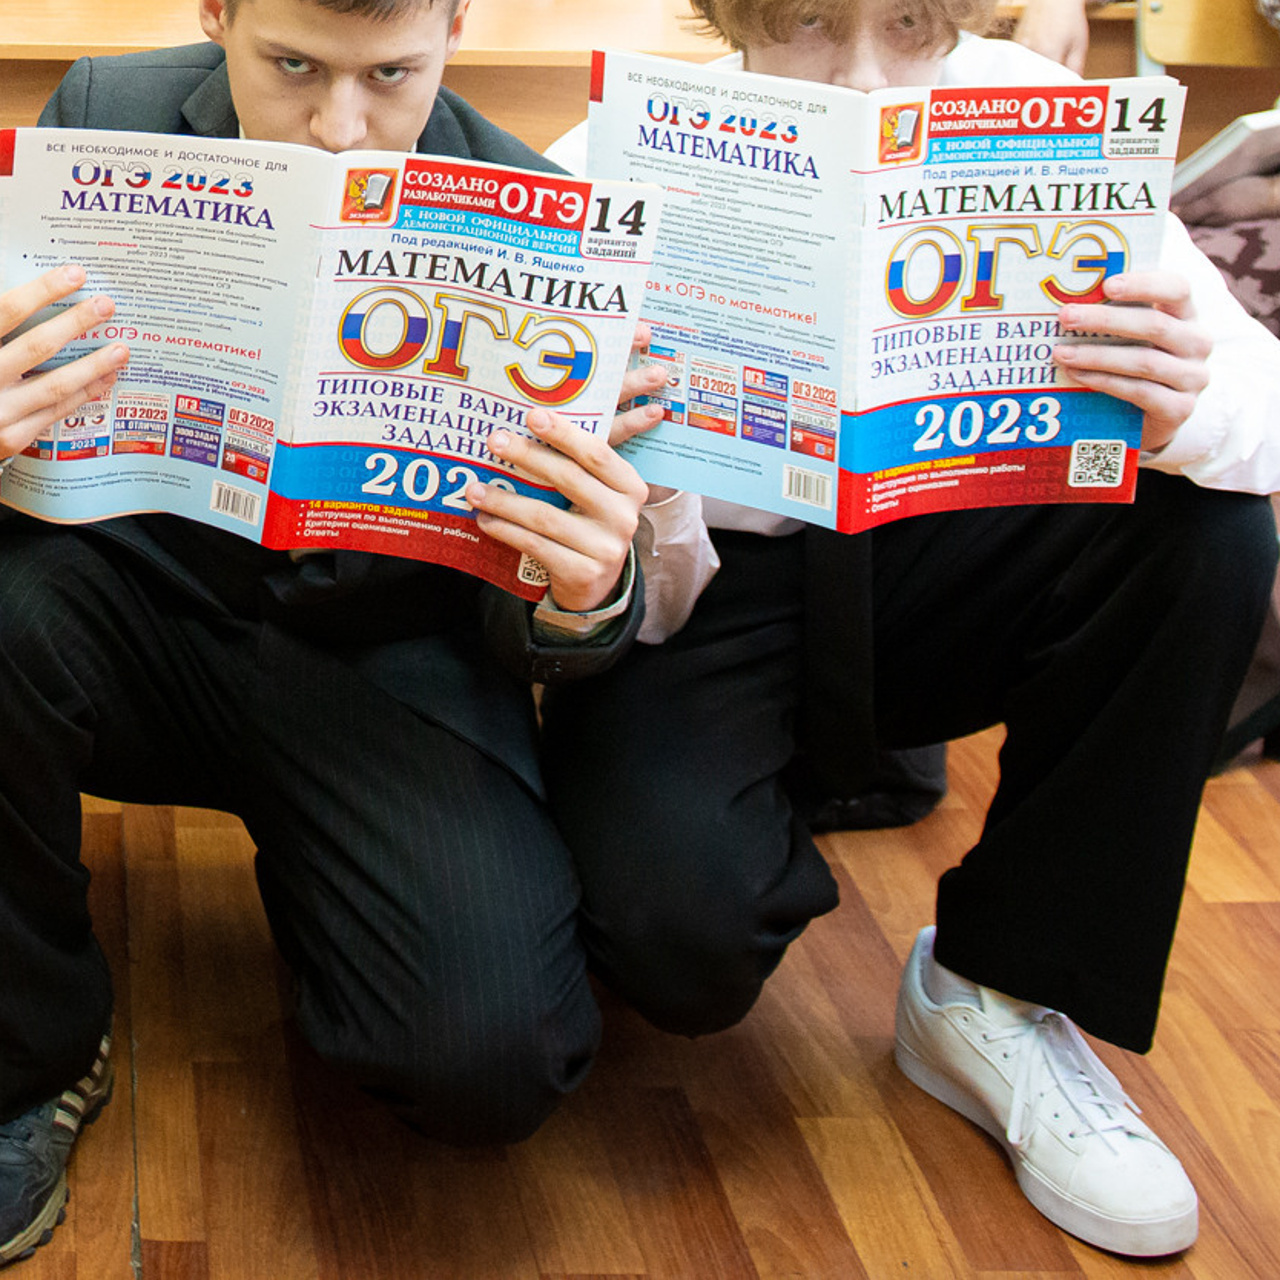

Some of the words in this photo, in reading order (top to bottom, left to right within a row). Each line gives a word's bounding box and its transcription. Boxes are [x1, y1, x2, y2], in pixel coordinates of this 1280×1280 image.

[628, 72, 643, 83] ВСЕ
[646, 77, 717, 96] НЕОБХОДИМОЕ
[732, 91, 803, 111] ДОСТАТОЧНОЕ
[807, 103, 828, 114] ДЛЯ
[930, 99, 1020, 118] СОЗДАНО
[930, 118, 1019, 132] РАЗРАБОТЧИКАМИ
[1021, 96, 1104, 129] ОГЭ
[1111, 97, 1168, 134] 14
[46, 143, 65, 153] ВСЕ
[71, 145, 159, 158] НЕОБХОДИМОЕ
[165, 150, 173, 158] И
[178, 150, 260, 169] ДОСТАТОЧНОЕ
[265, 161, 288, 172] ДЛЯ
[637, 124, 820, 180] МАТЕМАТИКА
[932, 140, 941, 152] К
[946, 138, 992, 151] НОВОЙ
[996, 136, 1100, 150] ОФИЦИАЛЬНОЙ
[71, 158, 152, 189] ОГЭ
[161, 164, 254, 198] 2023
[404, 170, 499, 195] СОЗДАНО
[922, 168, 947, 180] Под
[950, 165, 1020, 180] редакцией
[1024, 165, 1038, 176] И.
[1041, 166, 1054, 176] В.
[1058, 165, 1109, 178] Ященко
[60, 189, 276, 230] МАТЕМАТИКА
[403, 189, 496, 209] РАЗРАБОТЧИКАМИ
[499, 182, 585, 224] ОГЭ
[878, 182, 1156, 222] МАТЕМАТИКА
[403, 209, 413, 219] К
[418, 209, 467, 224] НОВОЙ
[471, 215, 579, 245] ОФИЦИАЛЬНОЙ
[589, 197, 647, 237] 14
[391, 233, 419, 248] Под
[421, 236, 494, 258] редакцией
[497, 249, 510, 260] И.
[514, 252, 528, 265] В.
[531, 256, 585, 274] Ященко
[401, 219, 530, 248] ДЕМОНСТРАЦИОННОЙ
[532, 241, 577, 255] ВЕРСИИ
[585, 246, 637, 259] заданий
[587, 237, 638, 248] вариантов
[335, 249, 629, 313] МАТЕМАТИКА
[884, 219, 1131, 320] ОГЭ
[665, 283, 672, 292] к
[676, 282, 706, 300] ОГЭ
[709, 292, 726, 305] по
[729, 298, 818, 325] математике!
[92, 329, 100, 339] к
[104, 326, 138, 340] ОГЭ
[142, 333, 161, 342] по
[165, 335, 262, 361] математике!
[338, 285, 598, 407] ОГЭ
[928, 360, 1058, 392] ЗАДАНИЙ
[913, 396, 1061, 452] 2023
[306, 510, 362, 522] Инструкция
[363, 513, 377, 521] по
[378, 514, 442, 533] выполнению
[443, 526, 480, 543] работы
[308, 500, 322, 509] 14
[323, 501, 381, 512] вариантов
[382, 505, 429, 520] заданий
[303, 528, 340, 537] Ответы
[304, 520, 350, 529] Критерии
[351, 520, 410, 536] оценивания
